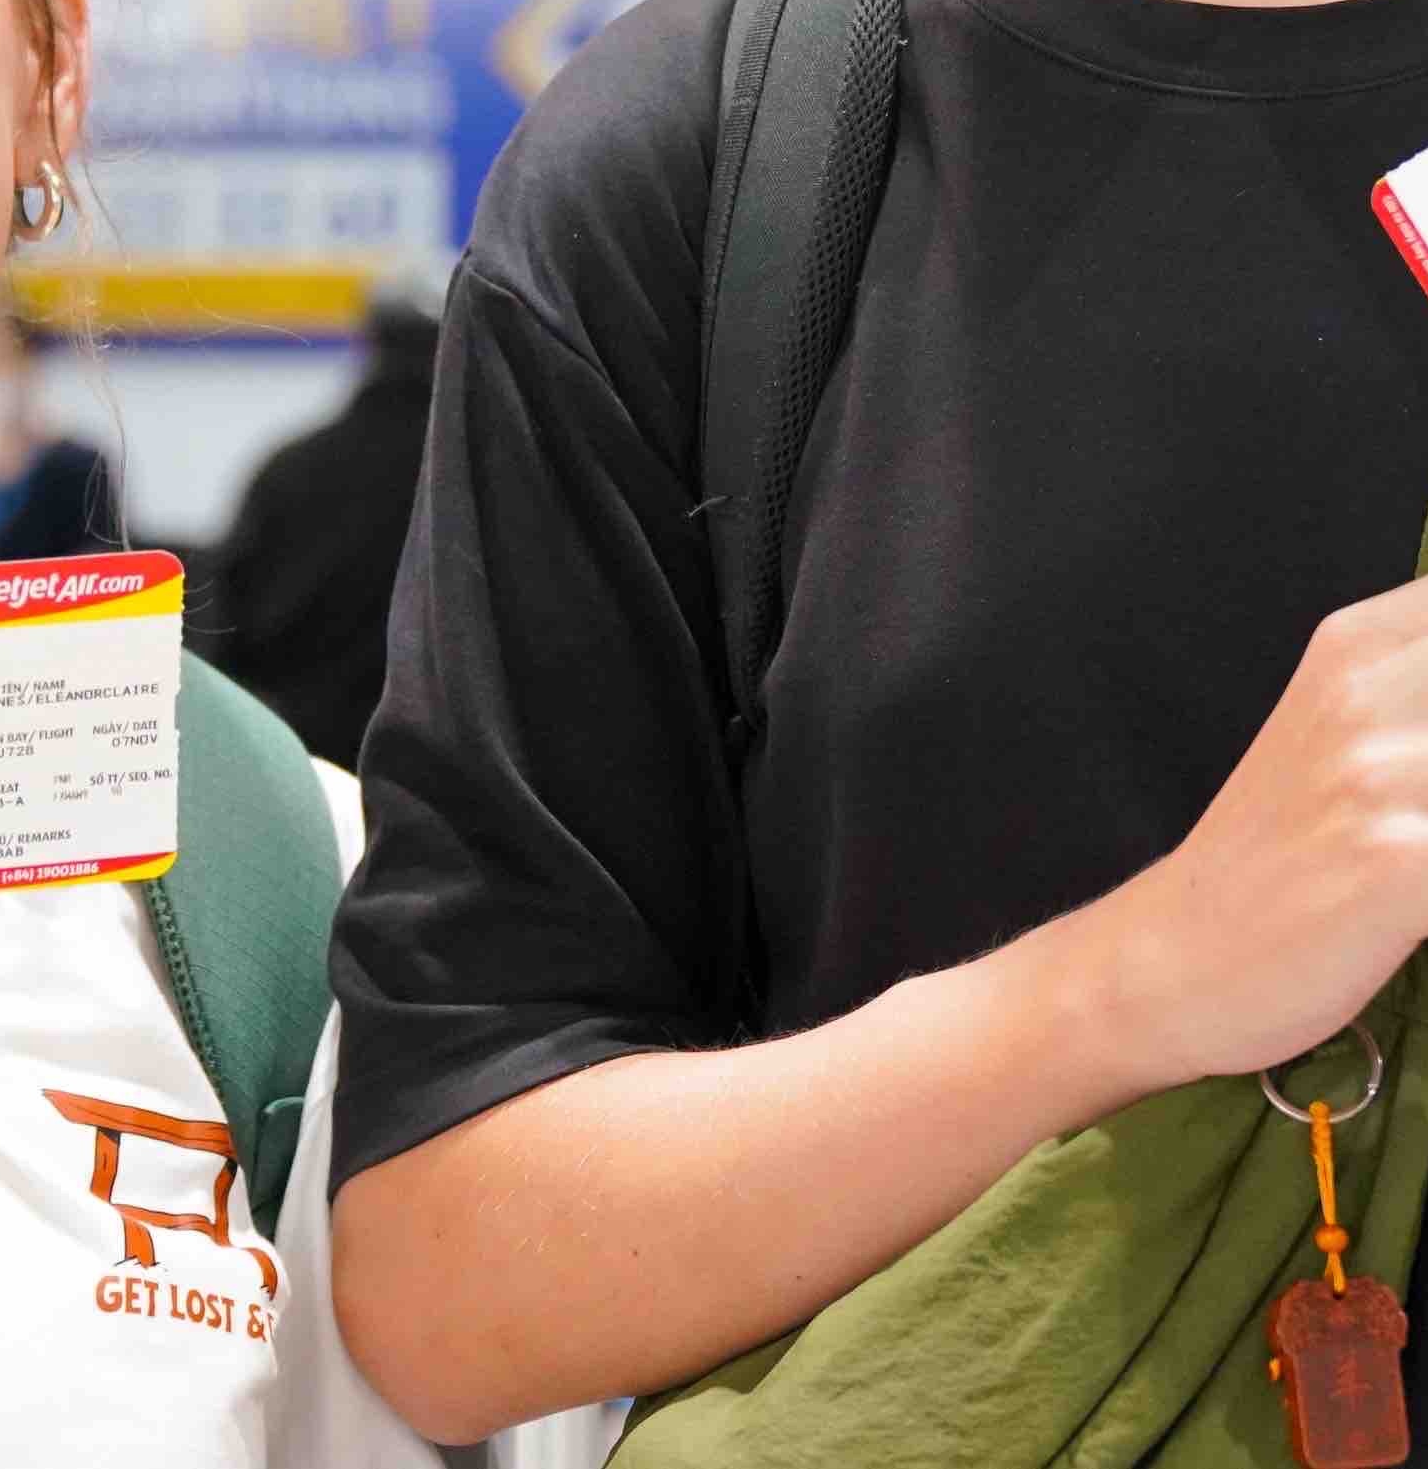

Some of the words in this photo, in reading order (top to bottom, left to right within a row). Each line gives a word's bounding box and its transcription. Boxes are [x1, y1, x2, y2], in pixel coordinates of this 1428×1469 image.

[33, 680, 66, 691] NAME
[132, 720, 157, 731] DATE
[7, 730, 35, 745] BAY/
[38, 728, 76, 740] FLIGHT
[111, 734, 158, 748] 07NOV
[17, 829, 72, 845] REMARKS
[1, 869, 32, 883] (+84)
[36, 861, 100, 880] 19001886
[96, 1275, 159, 1317] GET
[170, 1284, 235, 1333] LOST
[247, 1303, 267, 1343] &
